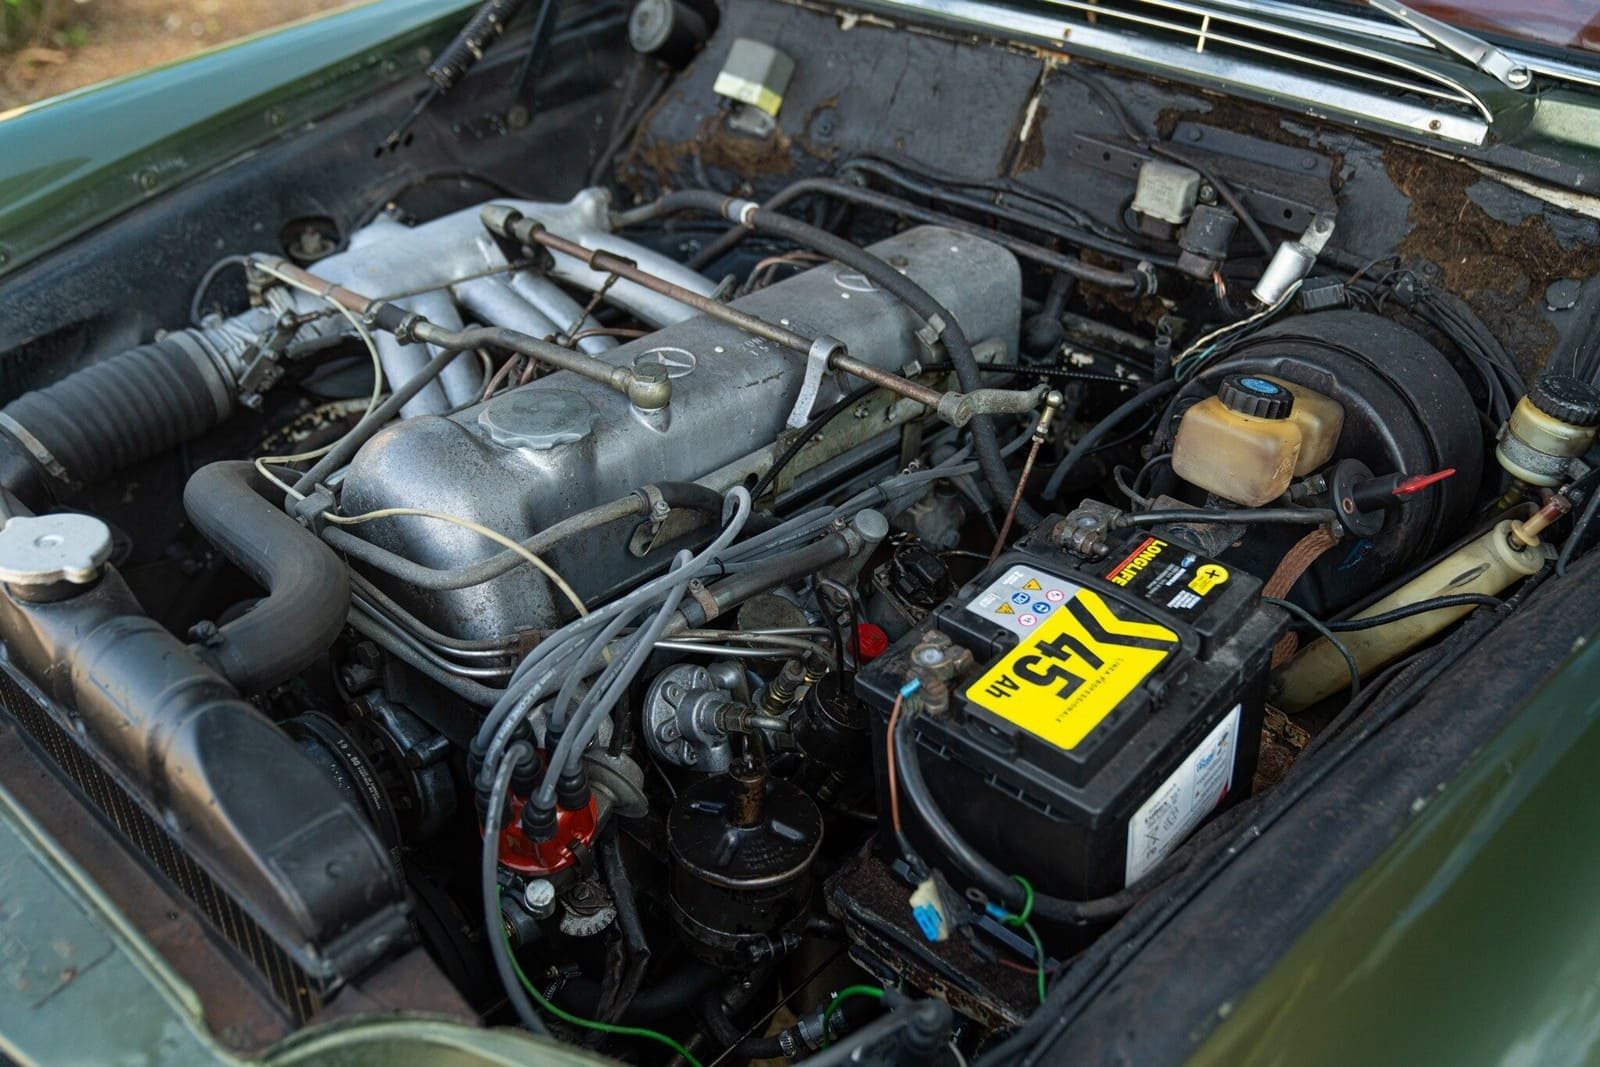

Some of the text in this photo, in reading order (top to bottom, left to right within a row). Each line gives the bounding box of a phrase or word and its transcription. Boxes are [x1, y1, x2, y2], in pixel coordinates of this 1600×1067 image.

[1111, 539, 1169, 587] LONGLIFE
[985, 632, 1105, 700] 45 Ah
